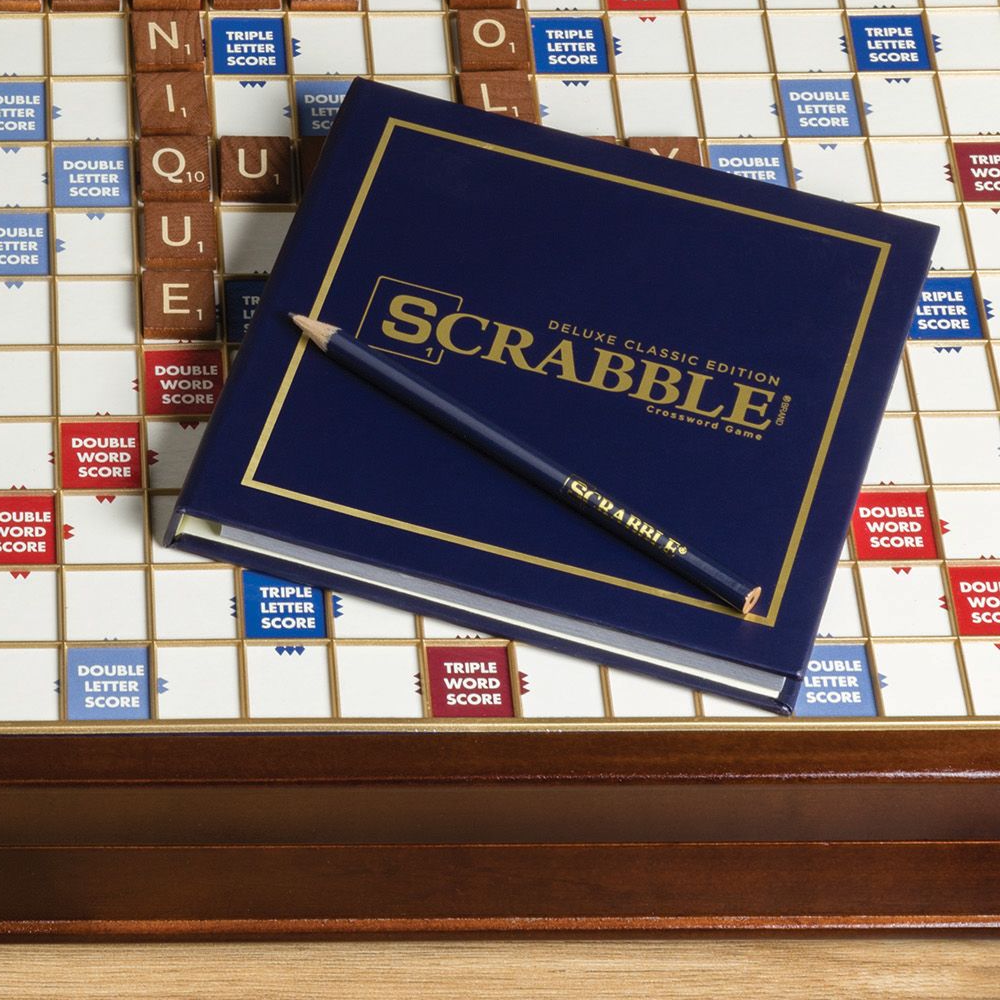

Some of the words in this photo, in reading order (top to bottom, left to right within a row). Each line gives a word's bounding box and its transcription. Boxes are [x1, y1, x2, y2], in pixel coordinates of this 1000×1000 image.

[225, 30, 273, 40] TRIPLE
[864, 26, 913, 37] TRIPLE
[226, 43, 275, 53] LETTER
[866, 39, 916, 49] LETTER
[226, 55, 276, 66] SCORE
[868, 51, 919, 62] SCORE
[62, 159, 123, 170] DOUBLE
[68, 172, 119, 184] LETTER
[68, 186, 120, 197] SCORE
[921, 290, 963, 302] RIPLE
[916, 304, 967, 315] LETTER
[917, 318, 970, 329] SCORE
[548, 319, 617, 346] DELUXE
[624, 339, 699, 366] CLASSIC
[705, 360, 781, 387] EDITION
[381, 294, 776, 430] SCRABBLE
[646, 405, 719, 430] Crossword
[724, 424, 763, 441] Game
[443, 661, 497, 673] TRIPLE
[443, 677, 500, 689] WORD
[446, 692, 502, 705] SCORE
